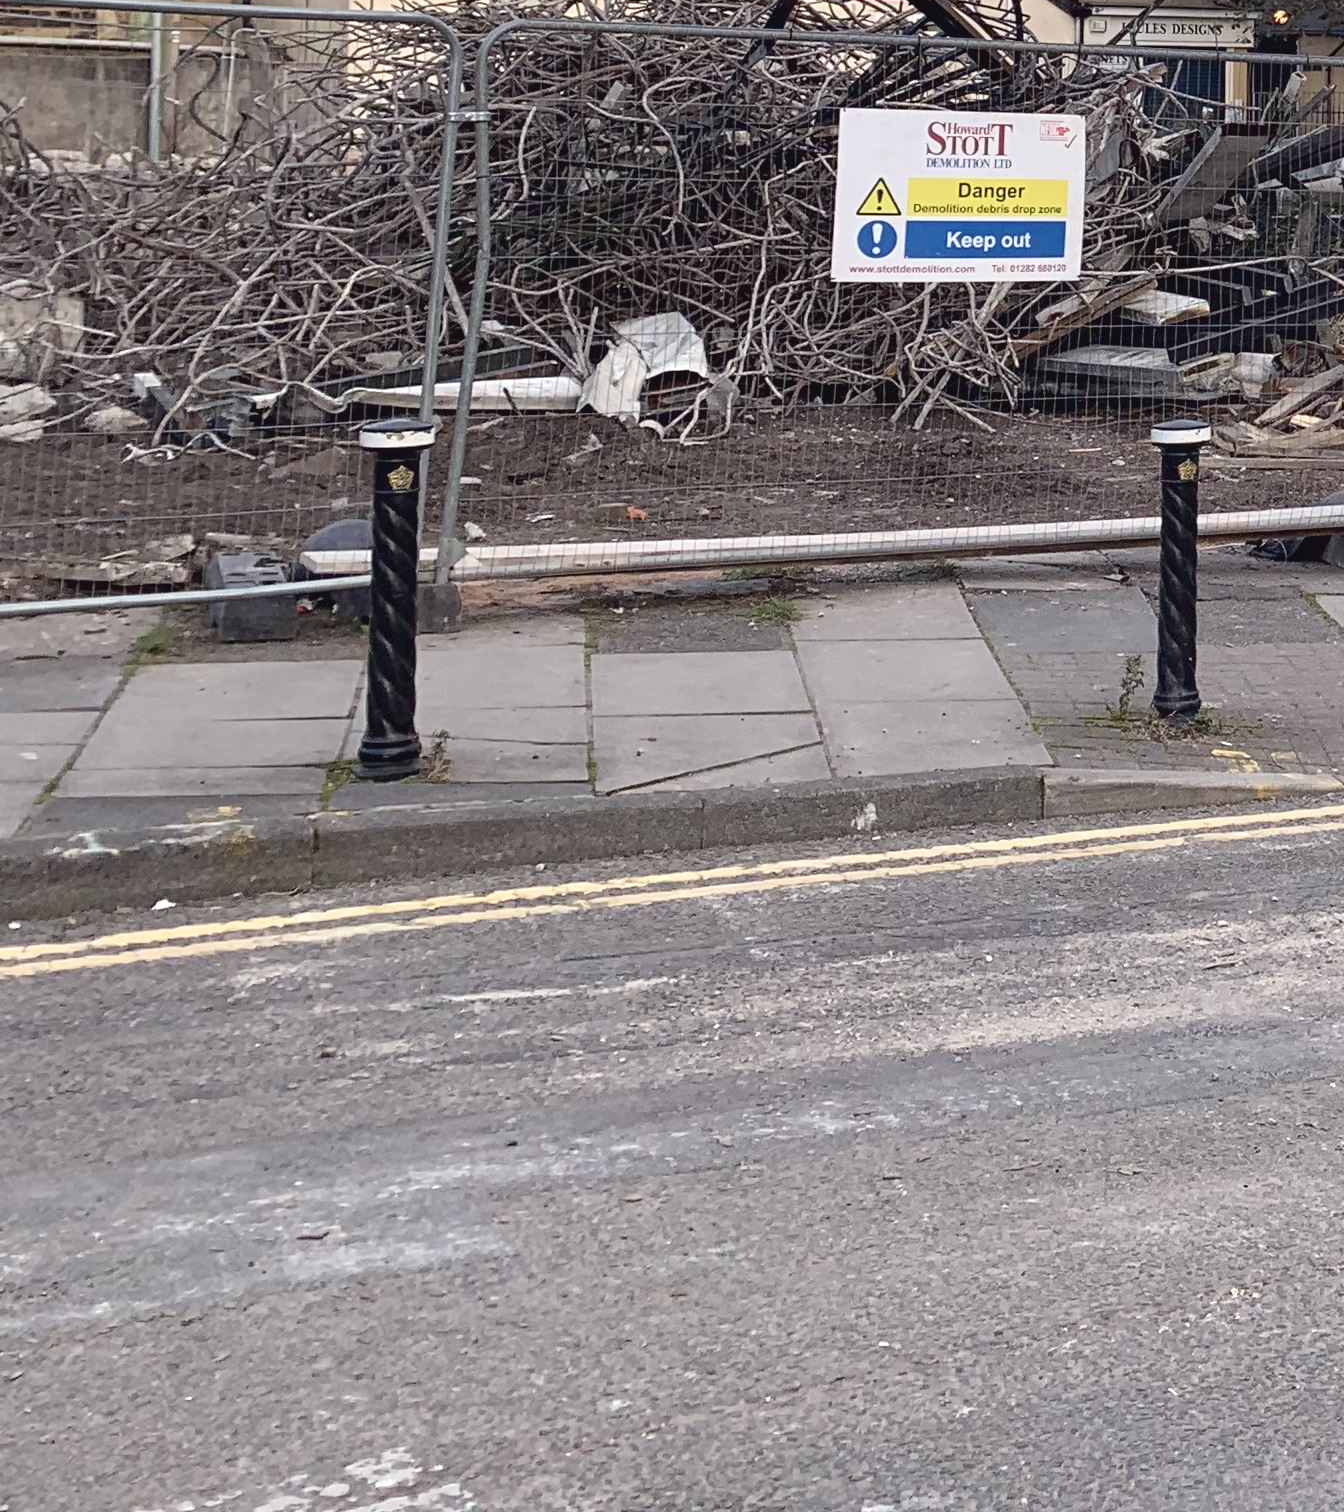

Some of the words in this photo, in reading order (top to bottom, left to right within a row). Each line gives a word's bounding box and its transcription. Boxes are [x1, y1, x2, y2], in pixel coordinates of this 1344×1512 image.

[1171, 23, 1223, 36] DESIGNS
[947, 122, 990, 136] Howard
[926, 121, 1012, 156] STOTT
[925, 157, 990, 169] DEMOLITION
[994, 158, 1012, 169] LTD
[958, 182, 1026, 202] Danger
[913, 203, 974, 214] Demolition
[976, 204, 1010, 214] debris
[1012, 205, 1036, 216] drop
[1038, 206, 1062, 214] zone
[946, 231, 996, 252] Keep
[1001, 232, 1032, 248] out
[849, 264, 975, 274] www.stottdemolition.com
[991, 264, 1008, 273] Tel:
[1009, 264, 1035, 273] 01282
